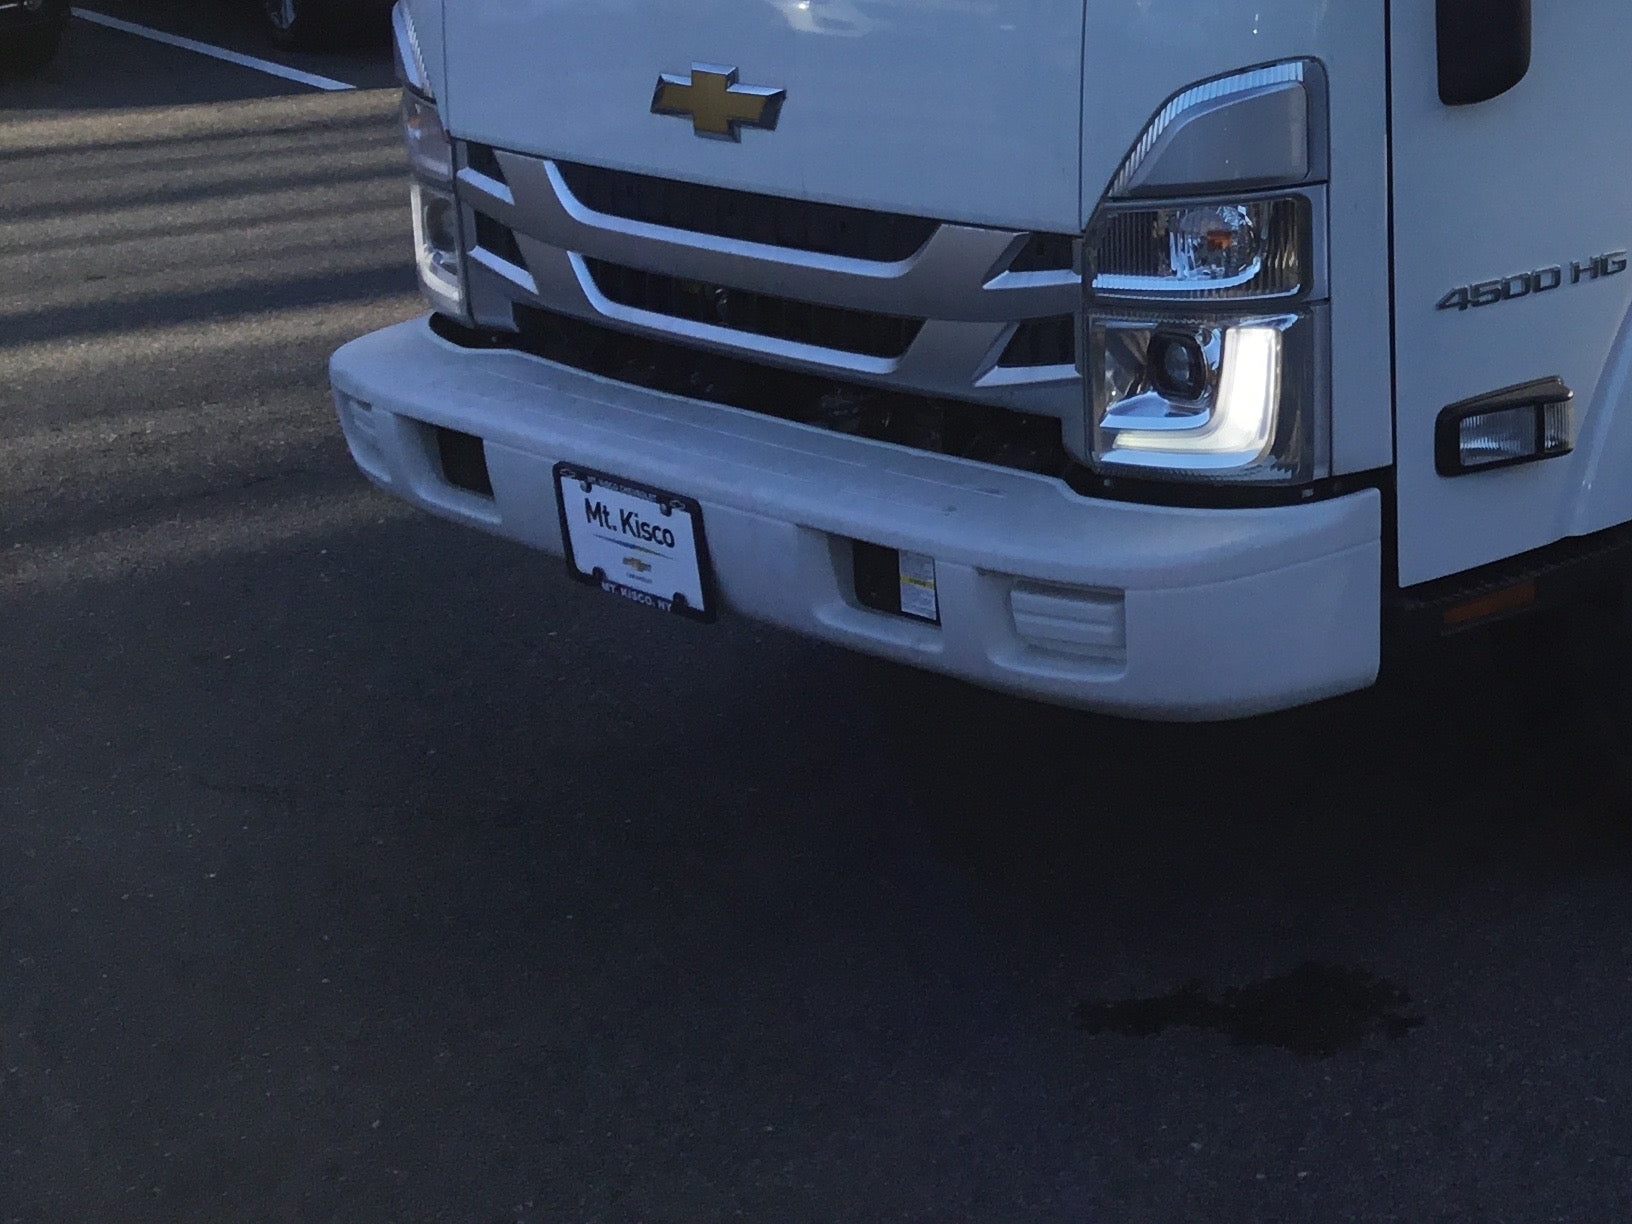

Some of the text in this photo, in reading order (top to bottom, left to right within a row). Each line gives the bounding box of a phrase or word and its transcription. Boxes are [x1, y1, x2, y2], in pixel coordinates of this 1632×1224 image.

[1435, 248, 1627, 311] 4500 HG
[584, 497, 675, 549] Mt. Kisco
